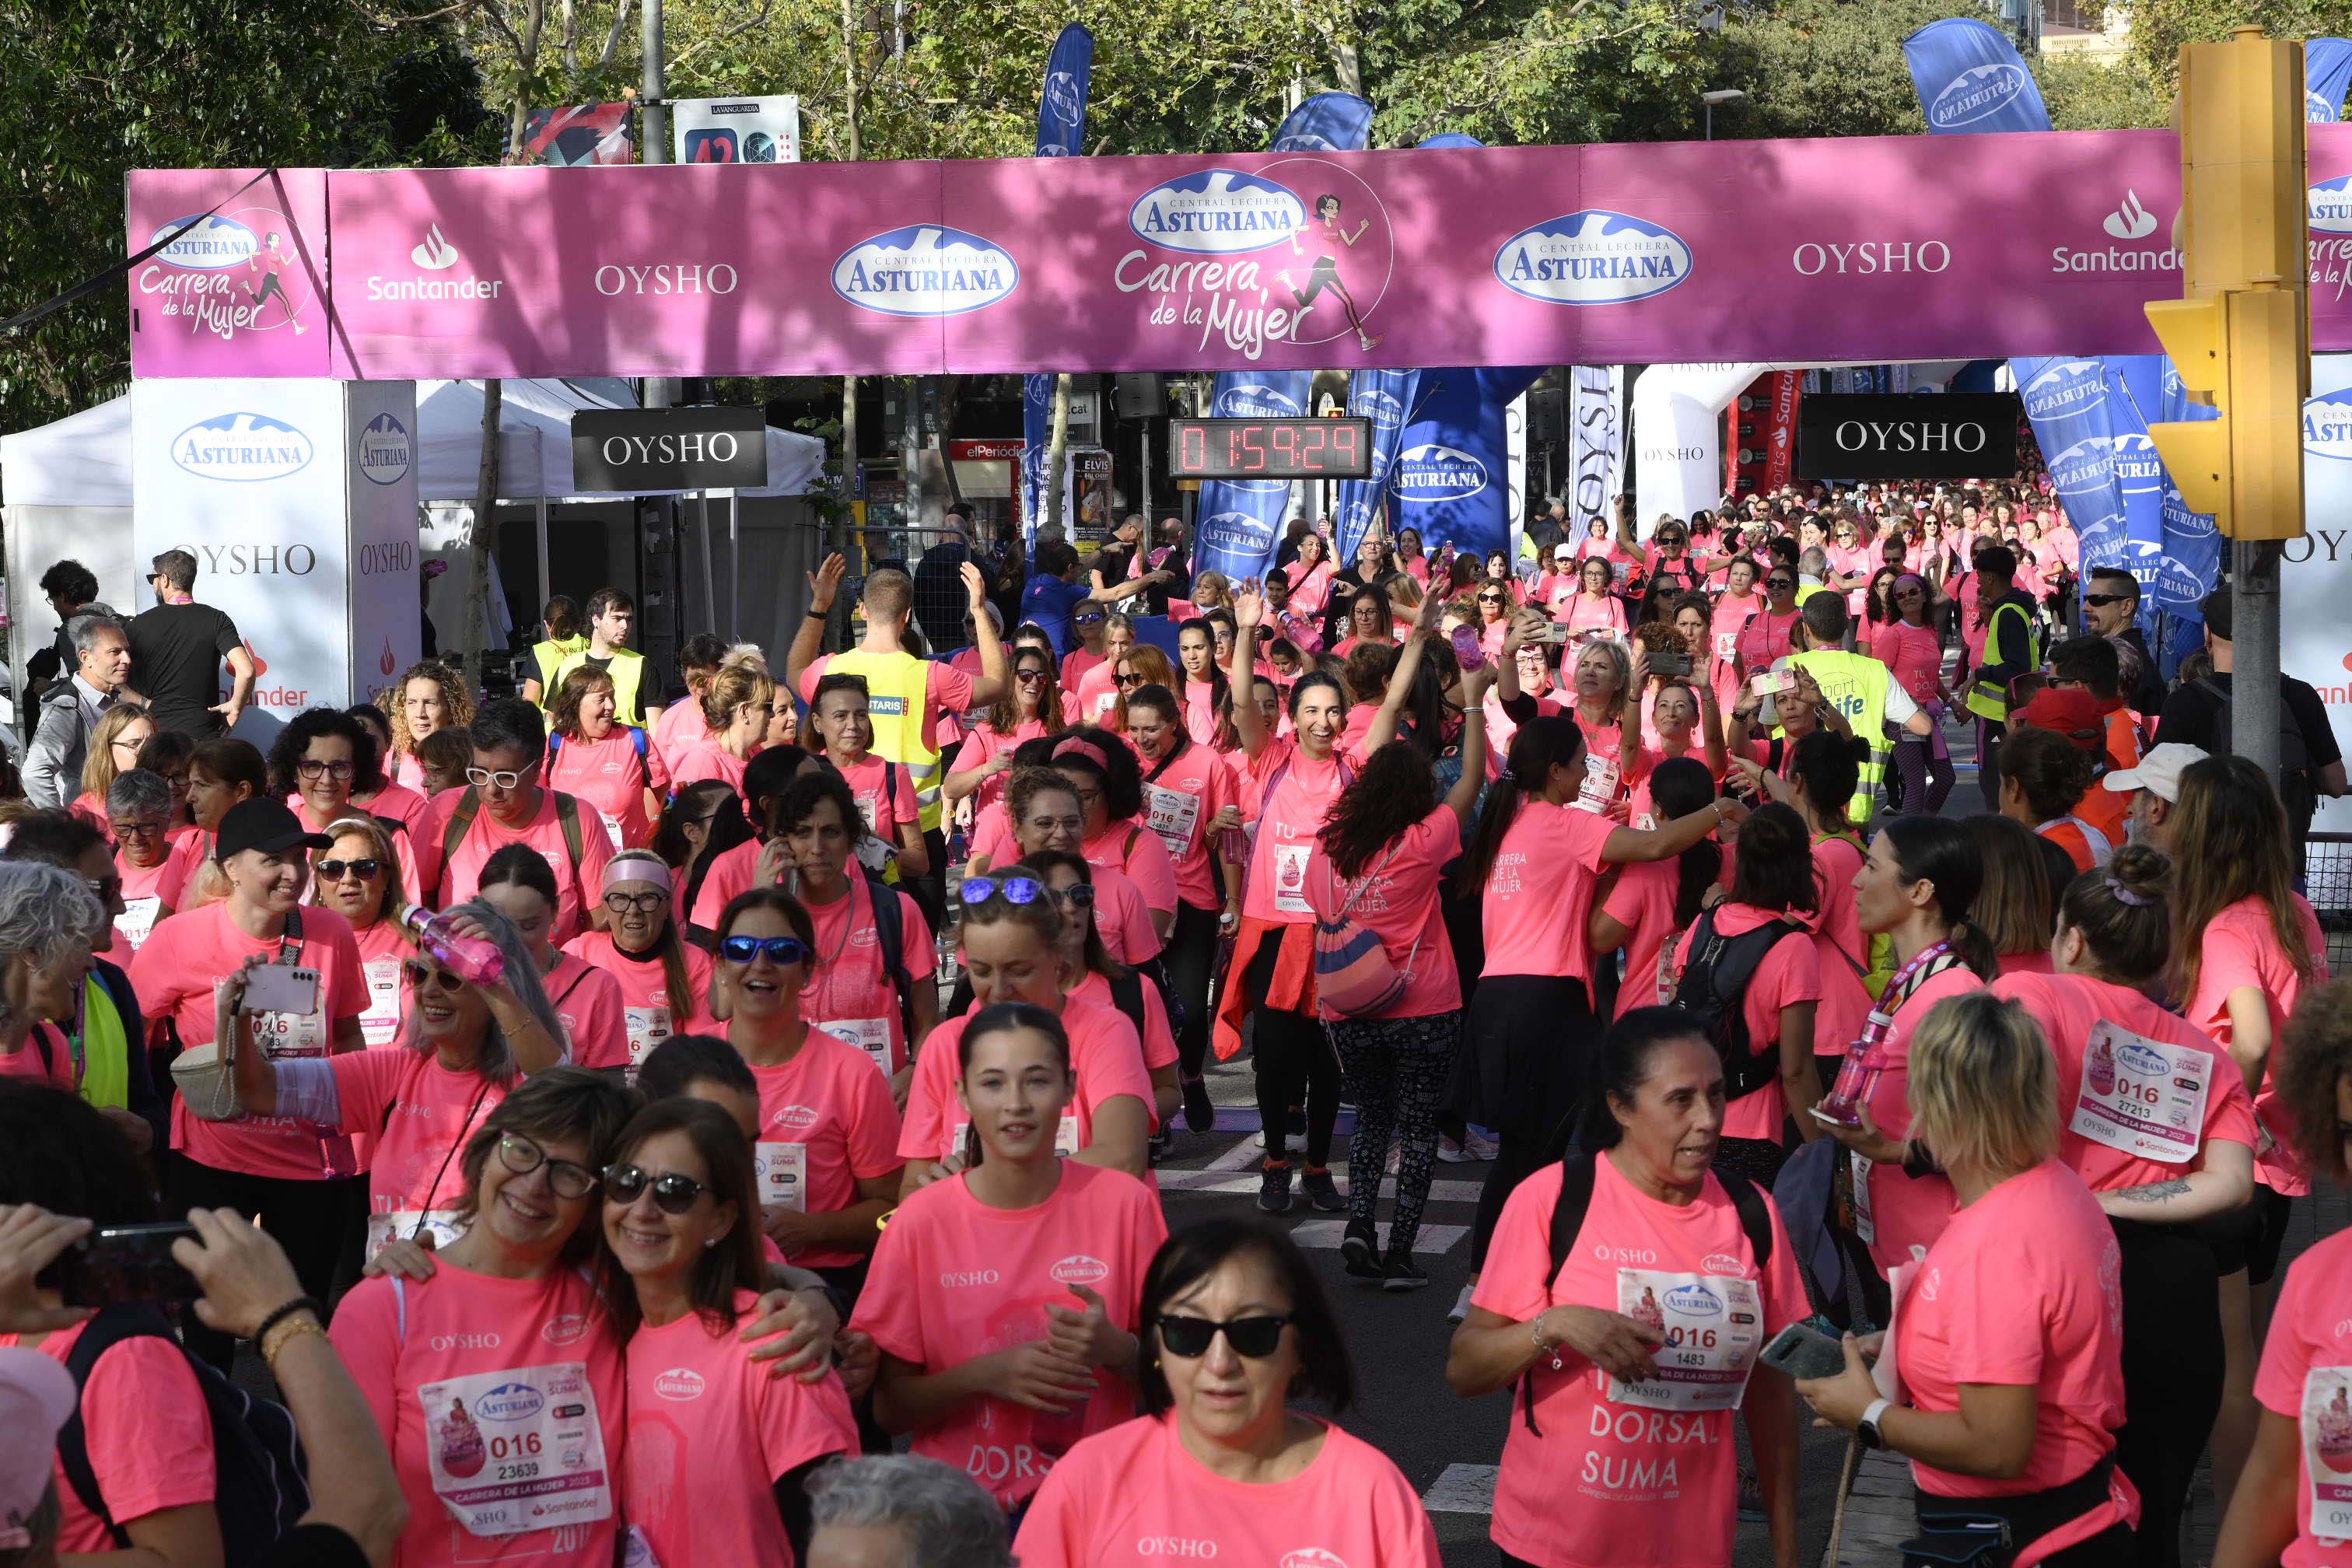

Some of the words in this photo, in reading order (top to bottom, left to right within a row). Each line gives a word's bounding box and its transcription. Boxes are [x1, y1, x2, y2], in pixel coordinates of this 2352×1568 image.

[1170, 198, 1225, 208] CENTRAL
[1230, 197, 1287, 207] LECHERA
[1143, 201, 1293, 233] ASTURIANA
[157, 234, 250, 256] ASTURIANA
[1539, 242, 1601, 254] CENTRAL
[1607, 241, 1671, 253] LECHERA
[2309, 239, 2352, 259] arre
[874, 255, 936, 265] CENTRAL
[939, 254, 998, 264] LECHERA
[1509, 247, 1677, 281] ASTURIANA
[1793, 240, 1951, 275] OYSHO
[2053, 246, 2185, 273] Santand
[139, 265, 229, 295] Carrera
[594, 263, 738, 296] OYSHO
[845, 259, 1004, 292] ASTURIANA
[1114, 250, 1261, 292] Carrera
[367, 275, 502, 300] Santander
[162, 300, 178, 316] de
[182, 297, 195, 315] la
[193, 291, 265, 340] Mujer
[1150, 297, 1178, 326] de
[1183, 296, 1202, 324] la
[1198, 286, 1315, 360] Mujer
[1577, 366, 1609, 515] OYSH
[1836, 421, 1986, 452] OYSHO
[183, 439, 303, 464] ASTURIANA
[362, 446, 408, 467] ASTURIANA
[603, 432, 738, 465] OYSHO
[1644, 446, 1703, 461] OYSHO
[1084, 460, 1108, 470] ELVIS
[1402, 463, 1436, 471] CENTRAL
[1391, 468, 1481, 490] ASTURIANA
[2164, 507, 2214, 531] STURIANA
[1205, 524, 1270, 550] ASTURIANA
[360, 541, 411, 575] OYSHO
[2159, 575, 2196, 598] URIANA
[1836, 694, 1864, 720] ife
[1153, 810, 1174, 823] 016
[1276, 822, 1295, 839] TU
[1495, 852, 1527, 866] ARRERA
[1493, 868, 1504, 880] DE
[1508, 866, 1518, 879] LA
[1367, 888, 1383, 899] LA
[1491, 880, 1521, 894] MUJER
[1345, 899, 1388, 912] MUJER
[253, 1020, 288, 1034] 06
[2119, 1051, 2167, 1075] ASTURIANA
[2175, 1062, 2201, 1074] SUMA
[2118, 1078, 2159, 1105] 016
[2091, 1102, 2117, 1122] CARRERA
[2118, 1115, 2129, 1125] DE
[2130, 1118, 2140, 1129] LA
[2140, 1122, 2167, 1136] MUJER
[2118, 1100, 2151, 1120] 27213
[2083, 1117, 2116, 1139] OYSHO
[2145, 1140, 2187, 1158] Santander
[1596, 1246, 1656, 1265] OYSHO
[1055, 1265, 1106, 1281] ASTURIANA
[1668, 1296, 1720, 1310] ASTURIANA
[431, 1332, 501, 1353] OYSHO
[1671, 1327, 1717, 1348] 016
[1675, 1353, 1705, 1366] 1483
[1675, 1370, 1685, 1379] DE
[1686, 1371, 1696, 1380] LA
[1624, 1383, 1671, 1399] OYSHO
[481, 1398, 540, 1415] ASTURIANA
[1590, 1405, 1718, 1444] DORSAL
[491, 1432, 542, 1459] 016
[498, 1462, 539, 1479] 23639
[967, 1444, 1058, 1479] DORS
[1581, 1450, 1678, 1489] SUMA
[455, 1487, 502, 1505] CARRERA
[504, 1486, 517, 1496] DE
[520, 1485, 530, 1495] LA
[533, 1480, 565, 1493] MUJER
[546, 1498, 598, 1515] Santander
[1137, 1536, 1217, 1559] OYSHO
